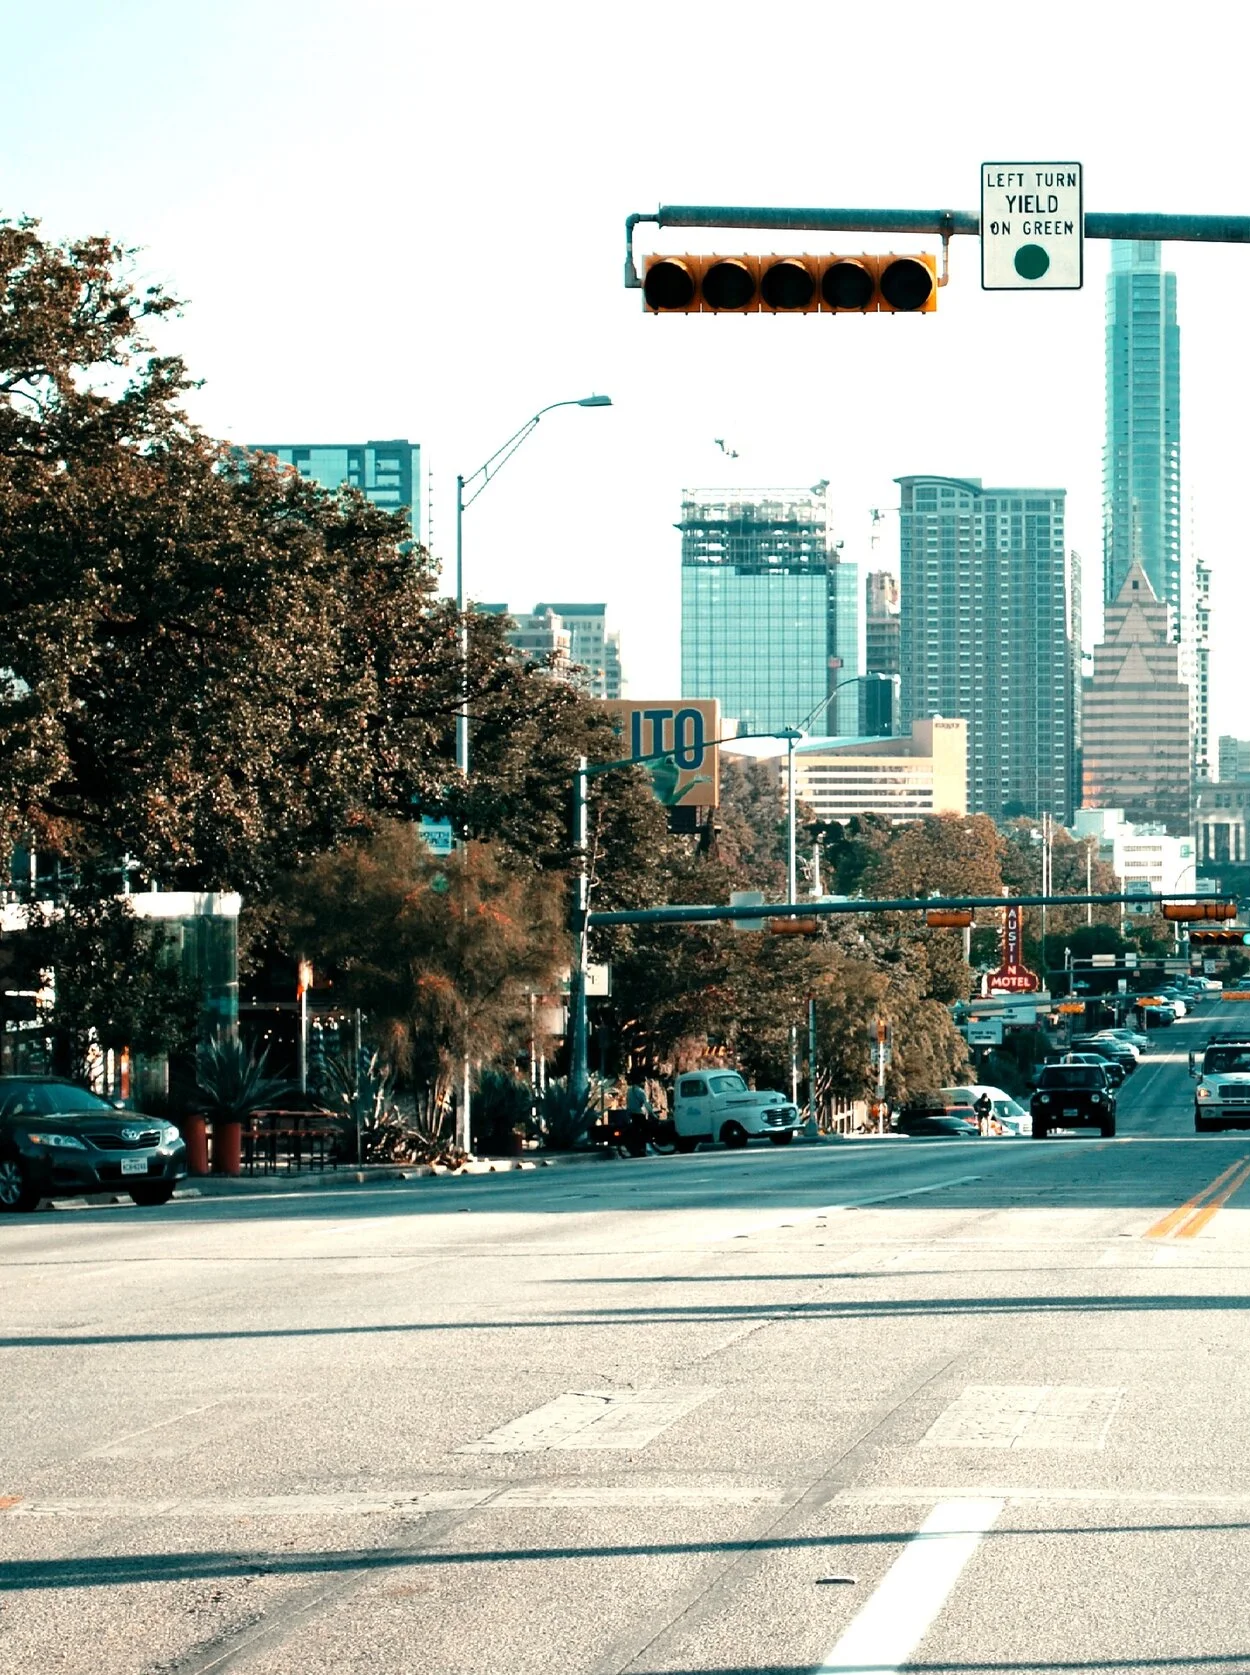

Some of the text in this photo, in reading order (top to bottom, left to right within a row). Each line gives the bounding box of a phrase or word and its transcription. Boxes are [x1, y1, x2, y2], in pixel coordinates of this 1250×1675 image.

[987, 173, 1076, 187] LEFT TURN
[1005, 195, 1058, 213] YIELD
[990, 221, 1073, 235] ON GREEN
[631, 708, 704, 770] ITO
[1008, 909, 1017, 975] AUSTIN
[991, 976, 1031, 987] MOTEL
